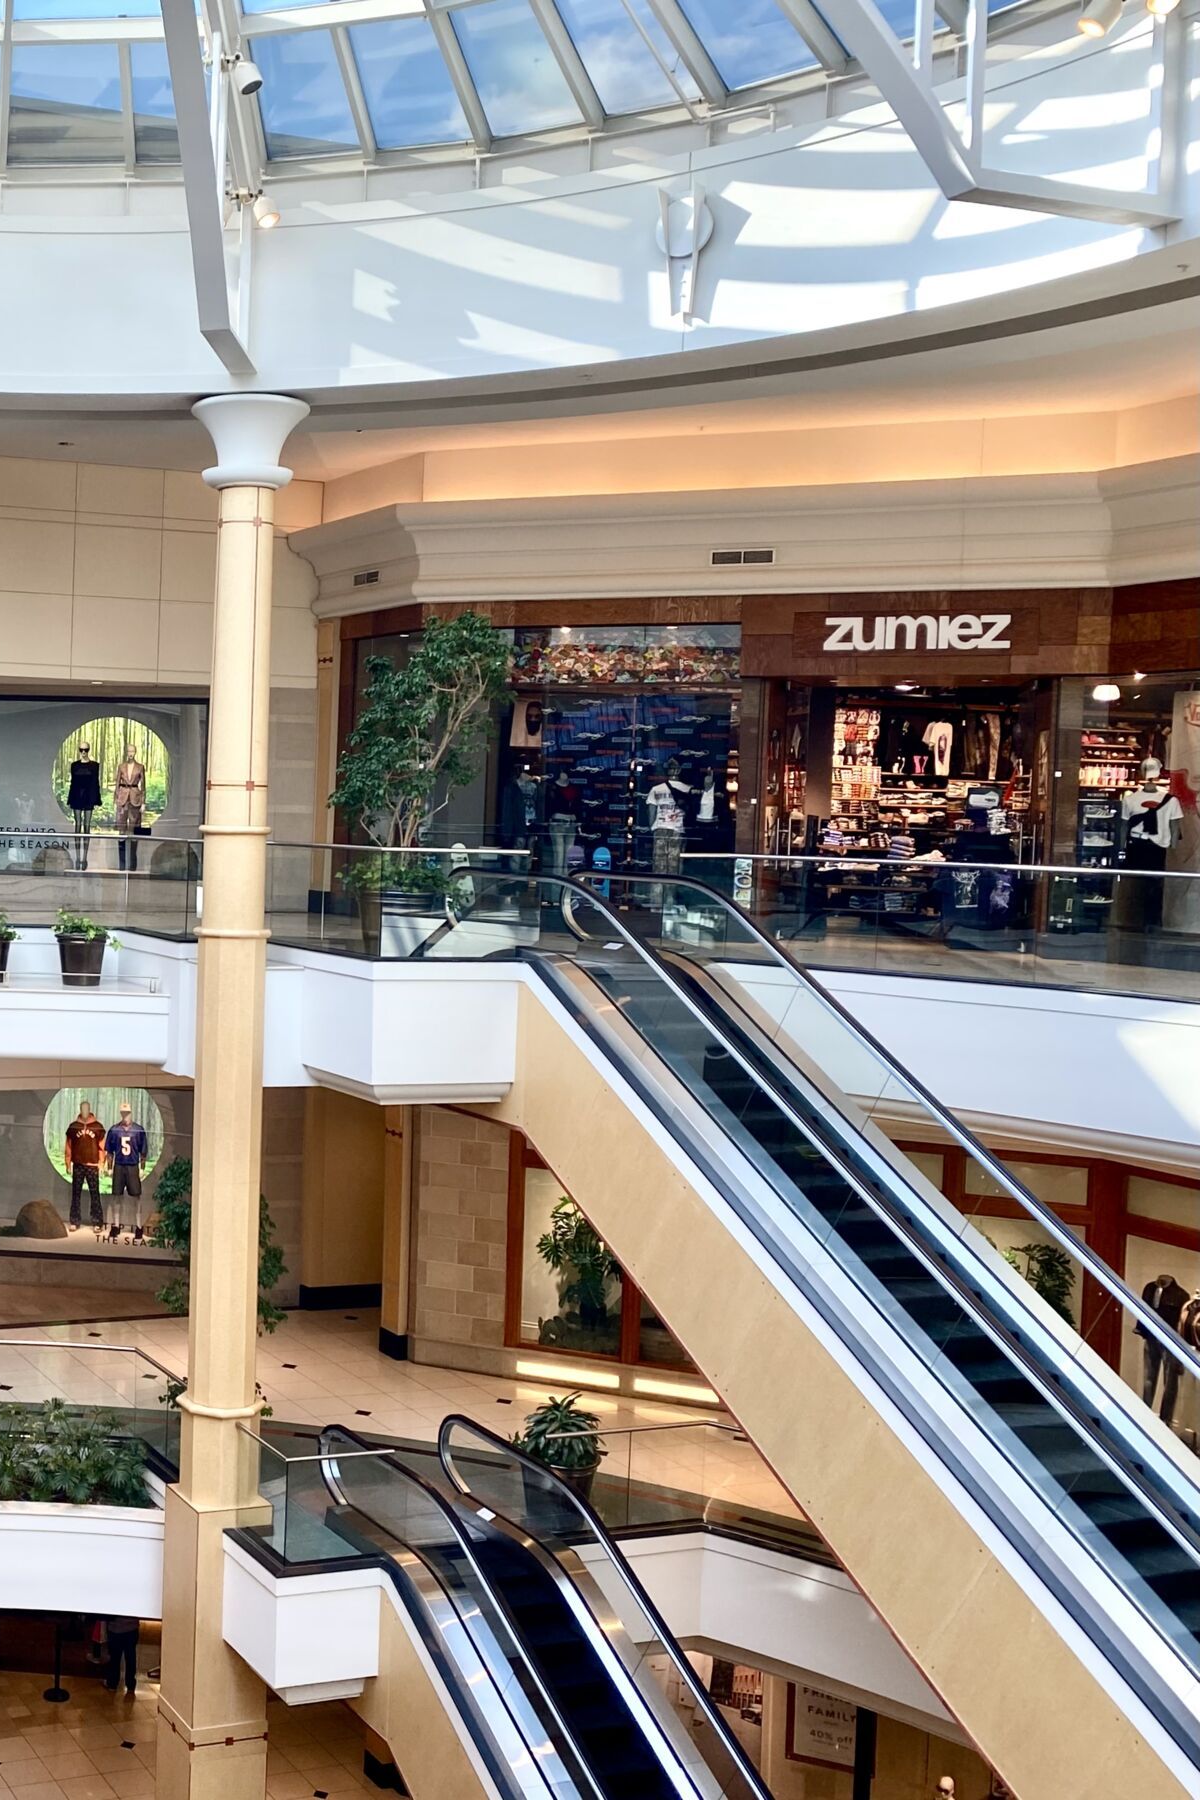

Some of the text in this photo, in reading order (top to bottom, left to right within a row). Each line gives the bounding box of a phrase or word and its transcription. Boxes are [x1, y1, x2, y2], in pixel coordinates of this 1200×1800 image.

[823, 614, 1011, 651] zumiez
[20, 840, 70, 849] SEASON
[121, 1136, 131, 1156] 5
[95, 1234, 119, 1246] THE
[808, 1705, 856, 1722] FAMILY
[809, 1729, 833, 1741] 40%
[836, 1735, 853, 1745] off
